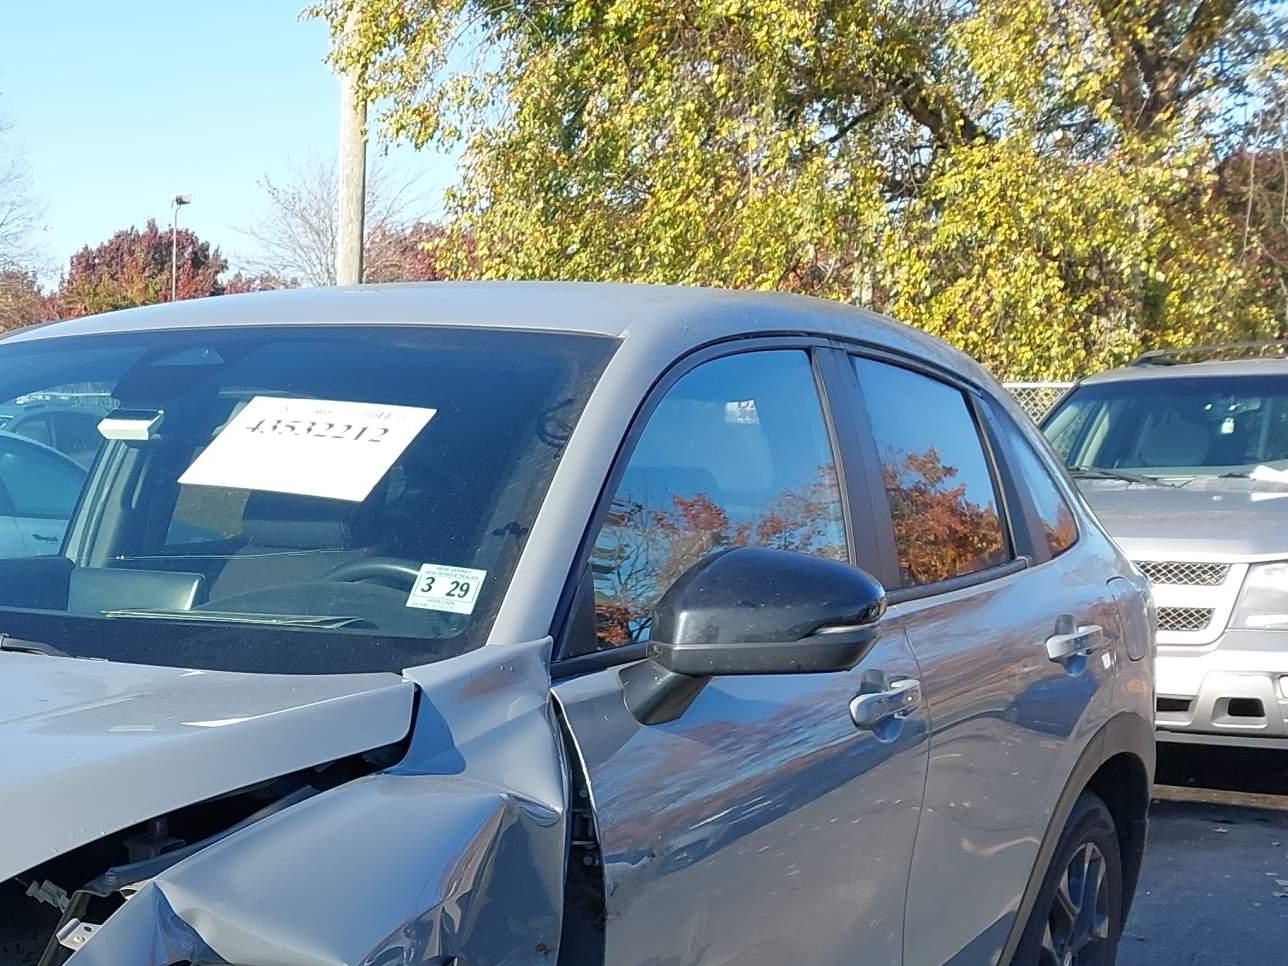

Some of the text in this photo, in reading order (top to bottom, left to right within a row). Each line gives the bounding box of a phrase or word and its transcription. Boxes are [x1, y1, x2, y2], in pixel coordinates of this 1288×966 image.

[246, 418, 389, 443] 43532212
[420, 576, 436, 593] 3
[445, 580, 471, 599] 29
